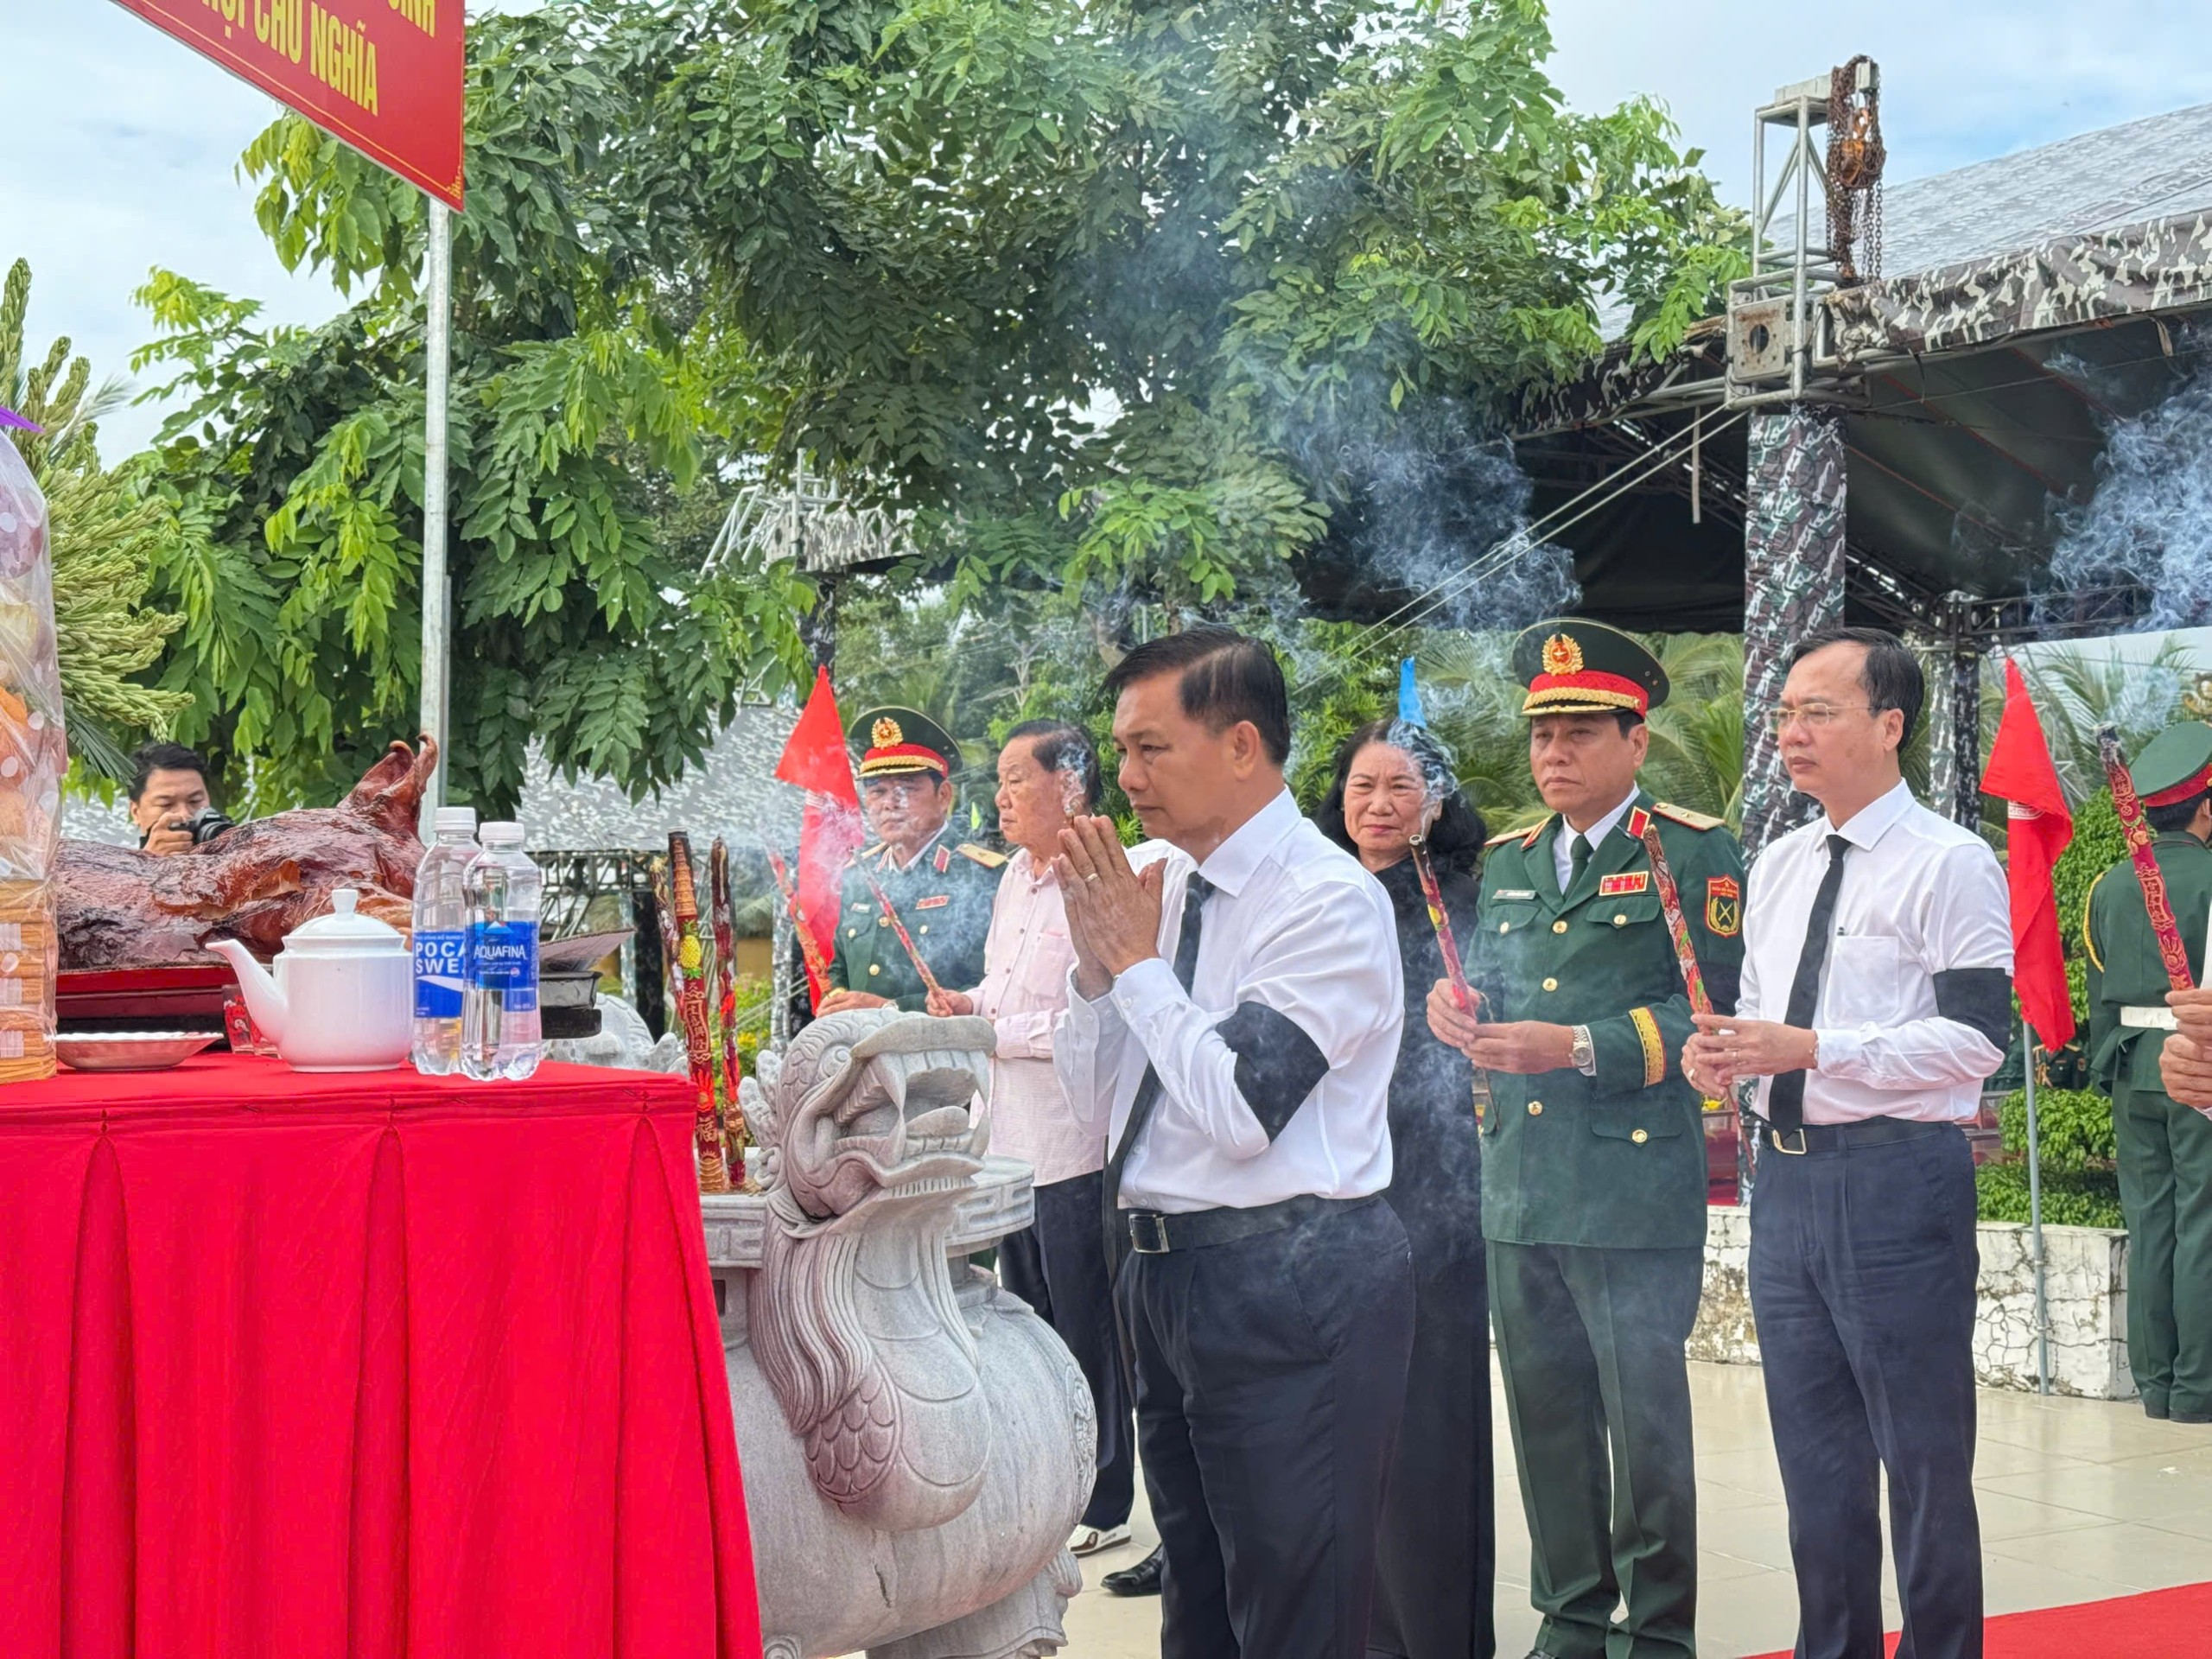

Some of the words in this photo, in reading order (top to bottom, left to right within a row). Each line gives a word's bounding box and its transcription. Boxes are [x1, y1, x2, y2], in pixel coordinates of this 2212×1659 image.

[310, 1, 378, 117] NGHĨA
[473, 944, 526, 960] AQUAFINA
[415, 958, 465, 974] SWE
